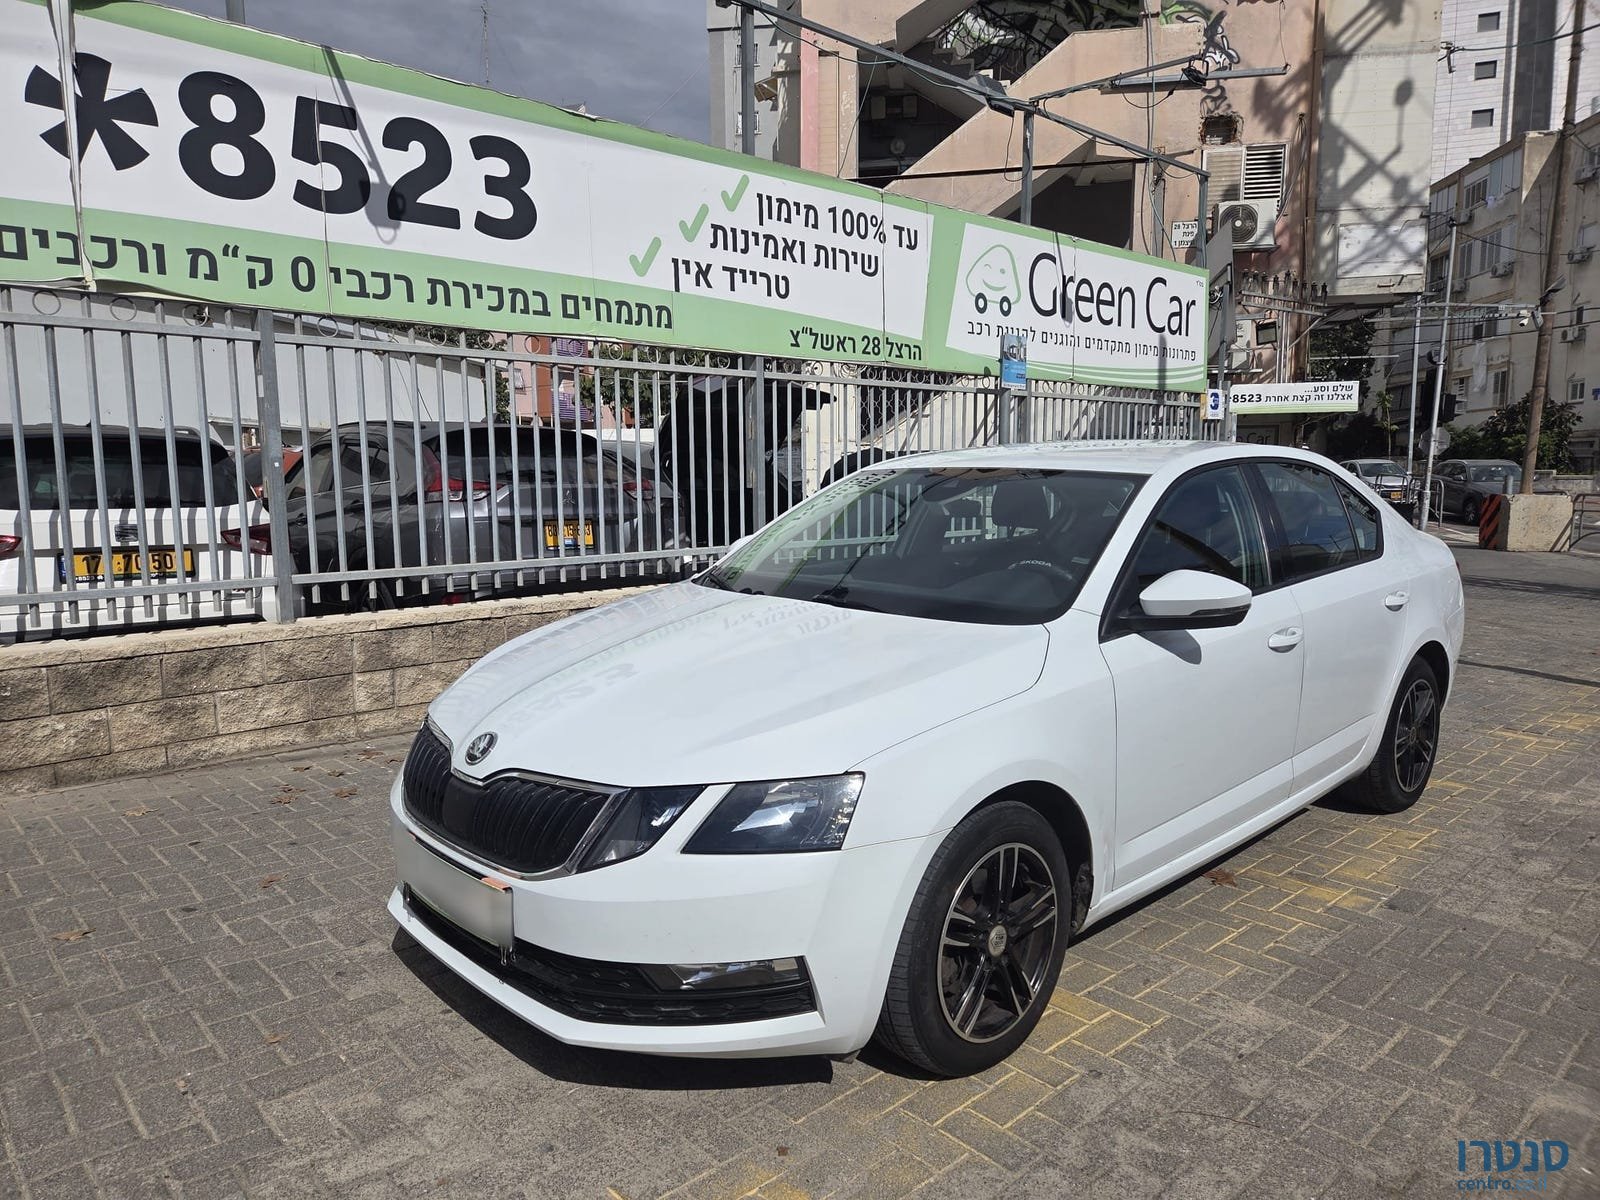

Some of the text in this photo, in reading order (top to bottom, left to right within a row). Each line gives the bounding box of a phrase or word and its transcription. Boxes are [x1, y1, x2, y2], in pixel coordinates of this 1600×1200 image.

[757, 193, 918, 250] עד 100% מימון
[1182, 222, 1198, 230] הרצל
[710, 223, 879, 277] שירות ואמינות
[0, 224, 673, 329] מתמחים במכירת רכבי 0 ק"מ ורכבים
[672, 257, 790, 299] טרייד אין
[1029, 252, 1197, 337] Green Car
[968, 321, 991, 336] רכב
[790, 326, 922, 361] הרצל 28 ראשל"צ
[1041, 331, 1080, 347] והוגנים
[1085, 337, 1131, 355] מתקדמים
[1135, 342, 1159, 358] מימון
[1162, 346, 1196, 361] פתרונות
[1332, 384, 1354, 392] שלם
[1265, 395, 1290, 403] אחרת
[1292, 394, 1311, 403] קצת
[1314, 393, 1324, 401] זה
[1327, 393, 1353, 401] אצלנו
